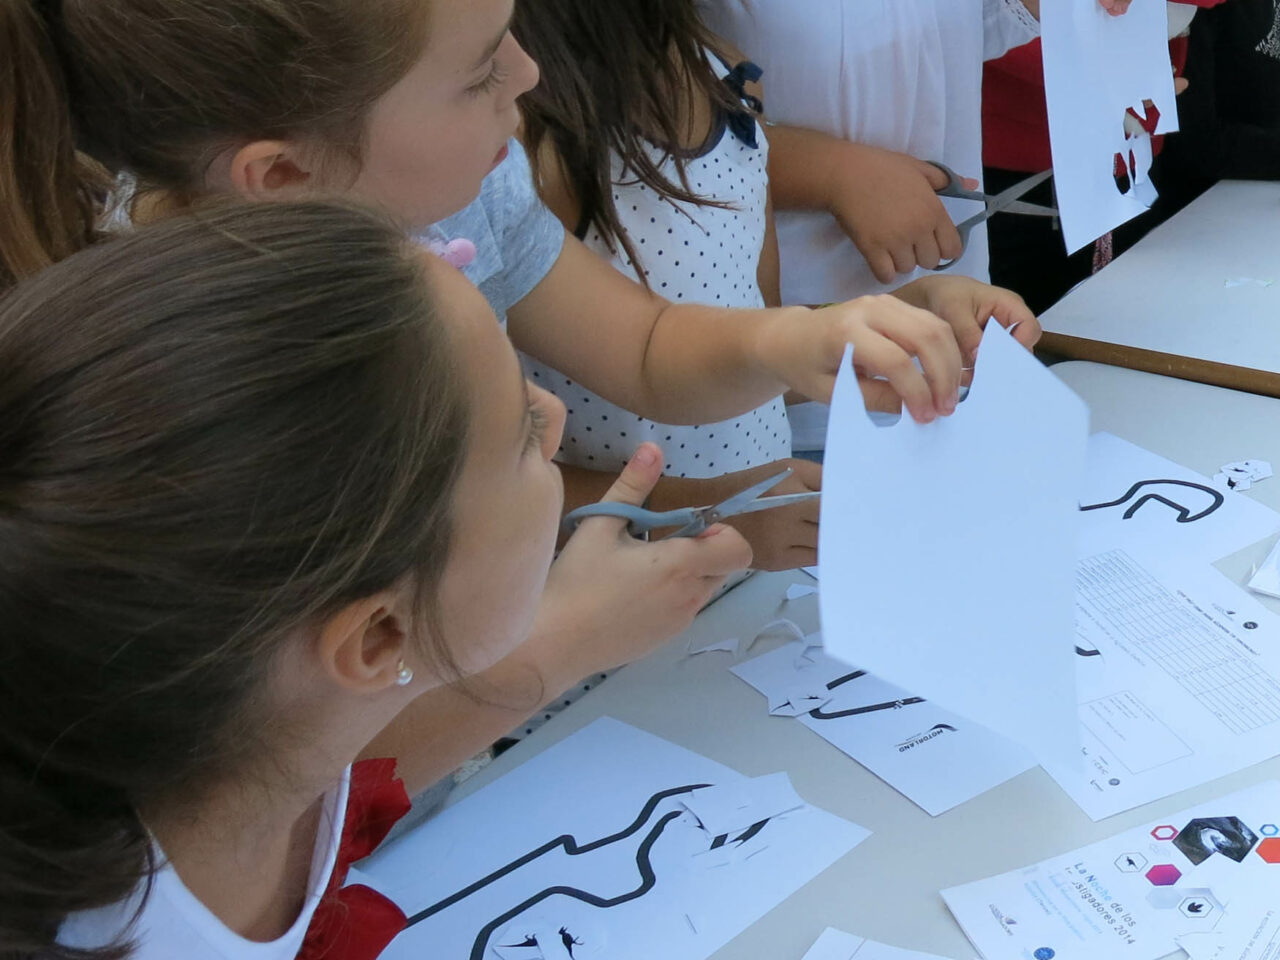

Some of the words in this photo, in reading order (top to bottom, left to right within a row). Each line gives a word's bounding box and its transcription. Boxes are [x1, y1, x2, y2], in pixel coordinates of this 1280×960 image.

[899, 729, 944, 752] MOTORLAND
[1074, 862, 1087, 874] La
[1110, 902, 1123, 913] de
[1121, 912, 1136, 927] los
[1114, 925, 1136, 944] 2014
